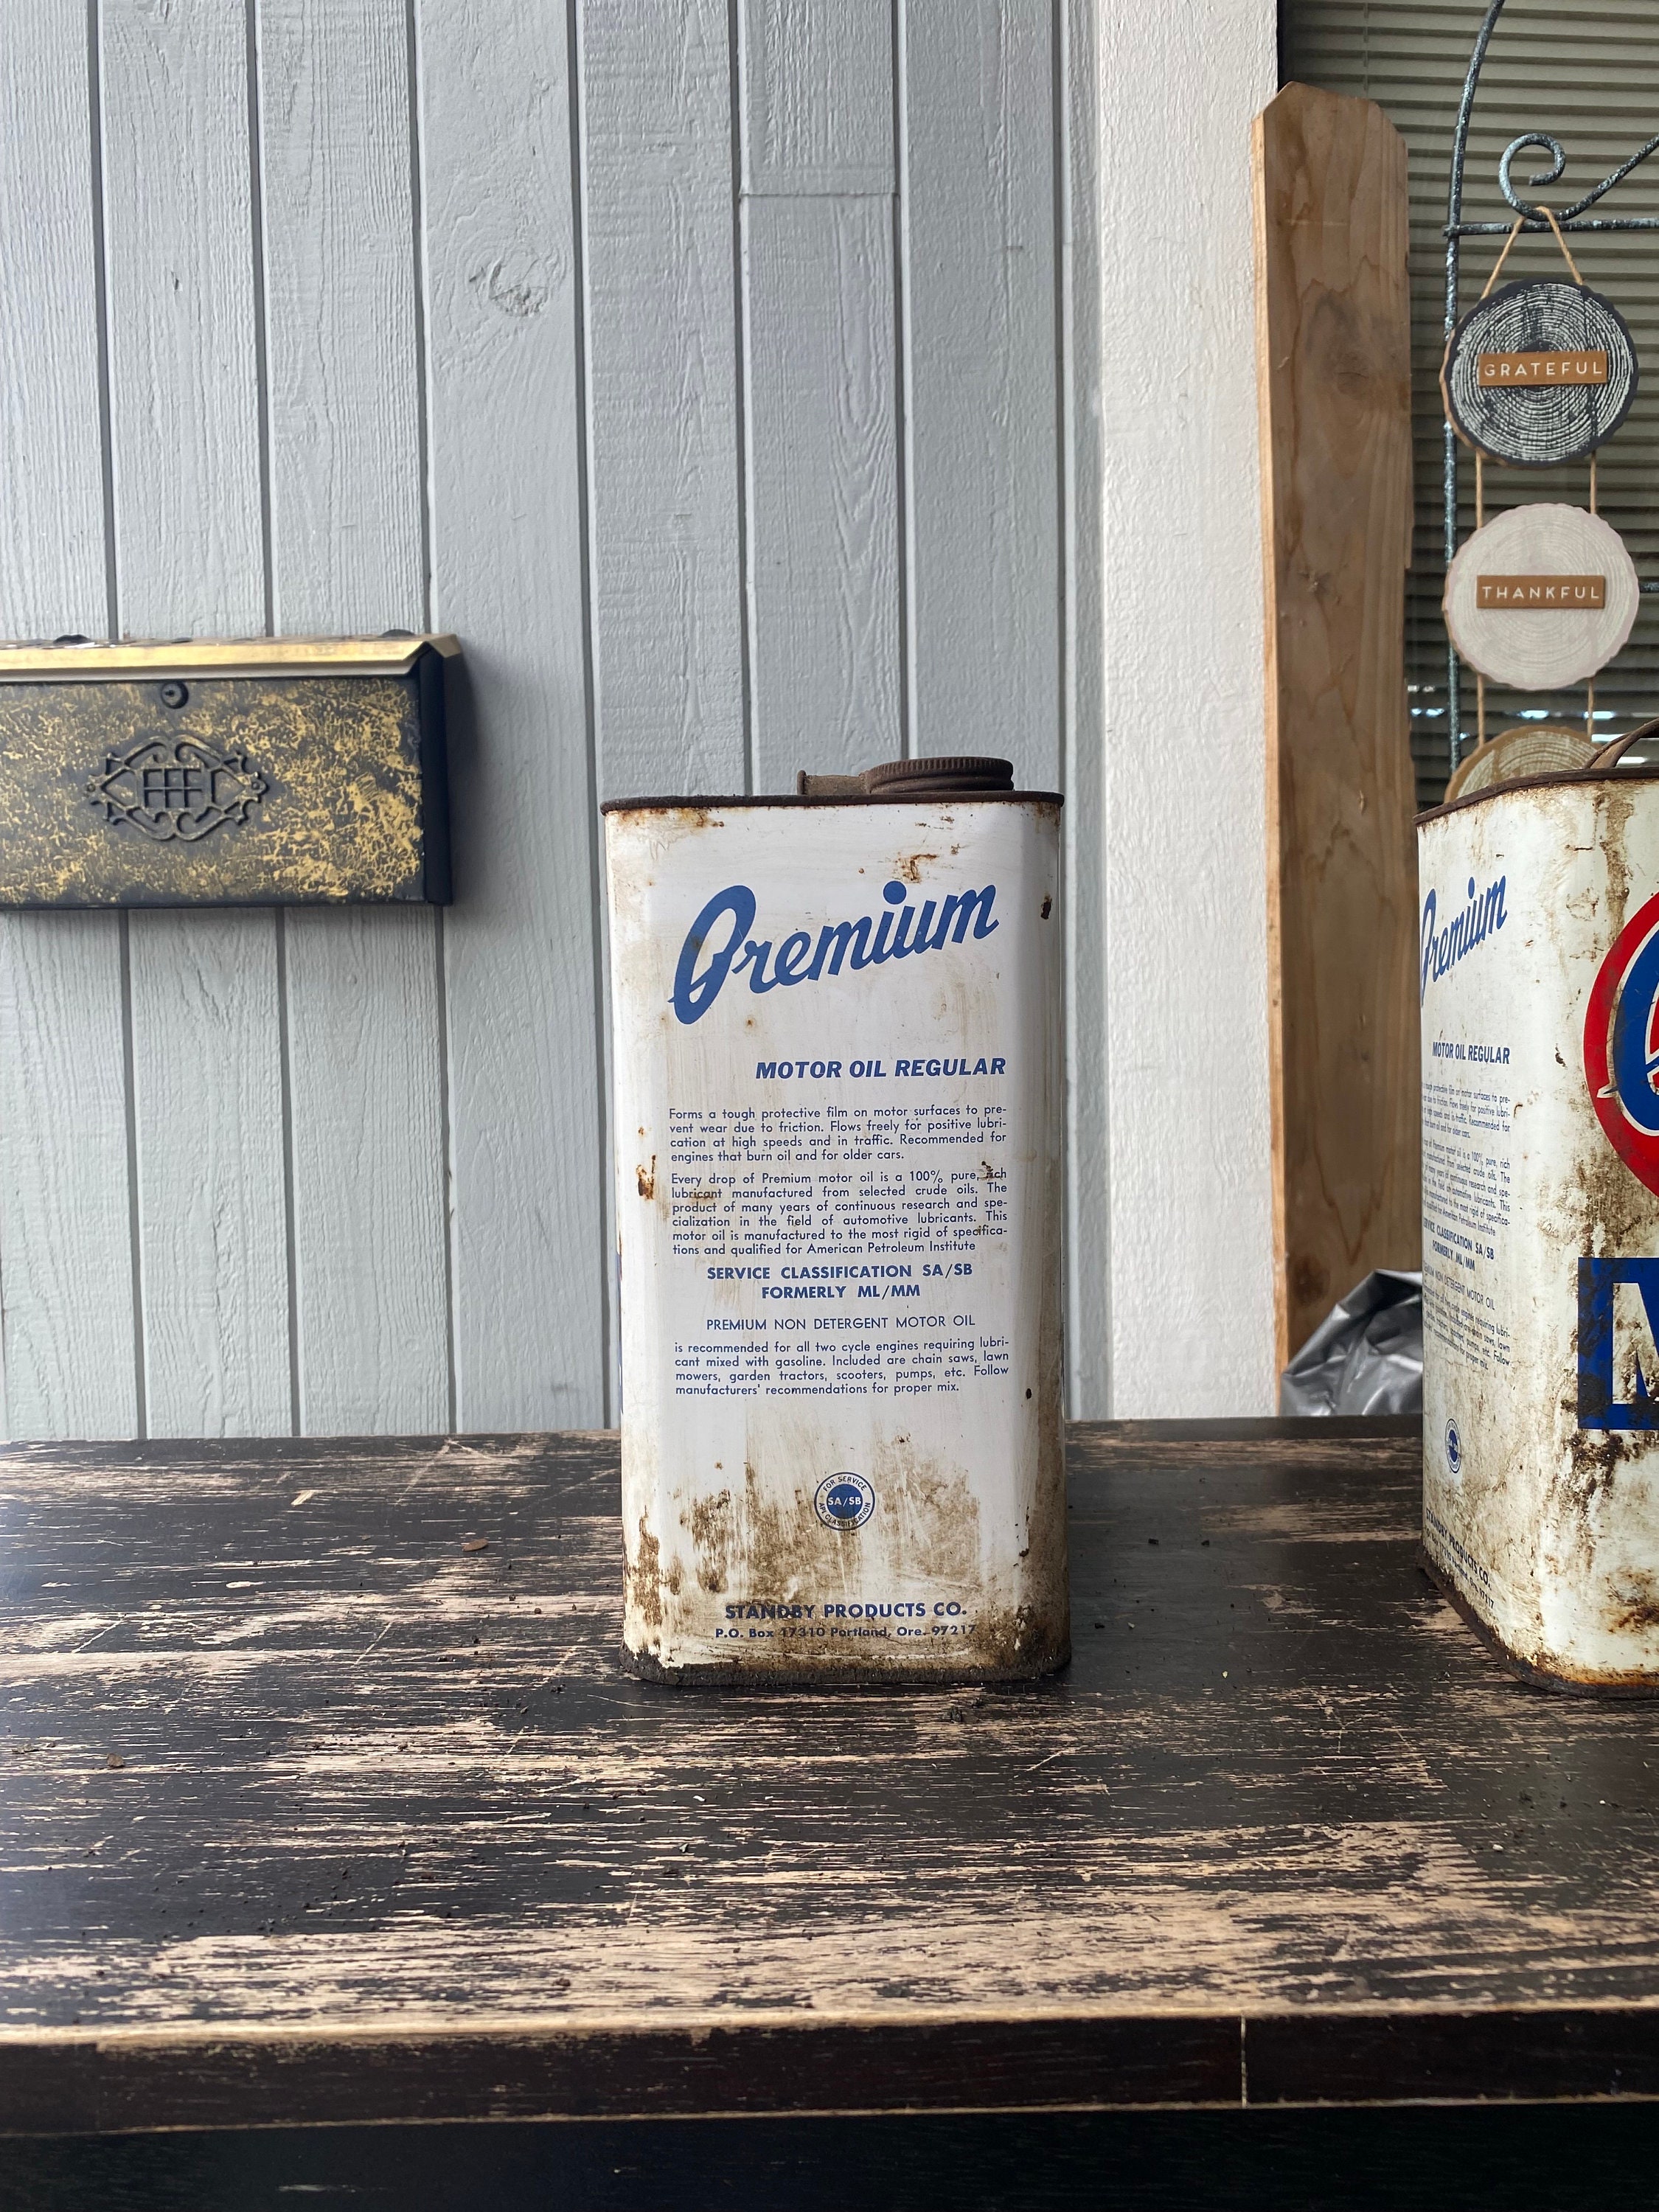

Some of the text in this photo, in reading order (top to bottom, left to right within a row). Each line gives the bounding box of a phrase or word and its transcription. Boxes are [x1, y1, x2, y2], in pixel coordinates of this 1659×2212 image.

[1484, 361, 1603, 377] GRATEFUL
[1481, 586, 1600, 599] THANKFUL
[1421, 874, 1507, 1008] Premium
[668, 880, 1000, 1024] Premium
[1432, 1041, 1510, 1064] MOTOR OIL REGULAR
[756, 1057, 1006, 1079] MOTOR OIL REGULAR
[669, 1108, 703, 1119] Forms
[722, 1107, 755, 1121] tough
[762, 1107, 821, 1121] protective
[826, 1106, 848, 1118] film
[874, 1106, 908, 1116] motor
[914, 1104, 960, 1116] surfaces
[966, 1105, 978, 1115] to
[984, 1106, 1006, 1118] pre-
[669, 1123, 694, 1133] vent
[734, 1121, 755, 1133] due
[761, 1122, 773, 1133] to
[779, 1121, 824, 1133] friction.
[830, 1120, 861, 1132] Flows
[866, 1119, 900, 1134] freely
[904, 1118, 922, 1130] for
[928, 1119, 972, 1133] positive
[978, 1116, 1006, 1128] lubri-
[670, 1130, 1006, 1150] cation at high speeds and in traffic. Recommended for
[671, 1151, 714, 1164] engines
[717, 1150, 742, 1161] that
[747, 1149, 772, 1161] burn
[777, 1149, 790, 1161] oil
[795, 1149, 817, 1161] and
[821, 1149, 838, 1161] for
[843, 1148, 873, 1160] older
[672, 1173, 702, 1187] Every
[709, 1172, 736, 1187] drop
[742, 1172, 755, 1183] of
[762, 1172, 811, 1183] Premium
[818, 1172, 853, 1183] motor
[860, 1171, 873, 1182] oil
[880, 1171, 888, 1182] is
[909, 1169, 944, 1185] 100%
[951, 1172, 979, 1184] pure,
[672, 1181, 1007, 1200] lubricant manufactured from selected crude oils. The
[672, 1196, 1007, 1216] product of many years of continuous research and spe-
[672, 1209, 1007, 1227] cialization in the field of automotive lubricants. This
[672, 1224, 1007, 1241] motor oil is manufactured to the most rigid of specifica-
[672, 1240, 975, 1258] tions and qualified for American Petroleum Institute
[1475, 1242, 1494, 1259] SA/SB
[707, 1263, 973, 1280] SERVICE CLASSIFICATION SA/SB
[762, 1284, 920, 1300] FORMERLY ML/MM
[707, 1315, 975, 1330] PREMIUM NON DETERGENT MOTOR OIL
[675, 1335, 1009, 1354] is recommended for all two cycle engines requiring lubri-
[675, 1357, 700, 1366] cant
[706, 1355, 739, 1367] mixed
[745, 1355, 768, 1367] with
[775, 1354, 826, 1369] gasoline.
[832, 1353, 880, 1366] Included
[911, 1352, 942, 1364] chain
[948, 1355, 977, 1364] saws,
[984, 1350, 1009, 1361] lawn
[675, 1364, 1009, 1383] mowers, garden tractors, scooters, pumps, etc. Follow
[675, 1380, 959, 1397] manufacturers' recommendations for proper mix.
[823, 1475, 867, 1492] FOR SERVICE
[827, 1497, 861, 1507] SA/SB
[725, 1601, 967, 1619] STANDBY PRODUCTS CO.
[715, 1628, 744, 1638] P.O.
[749, 1628, 774, 1638] Box
[830, 1626, 891, 1638] Portland,
[931, 1624, 976, 1636] 97217
